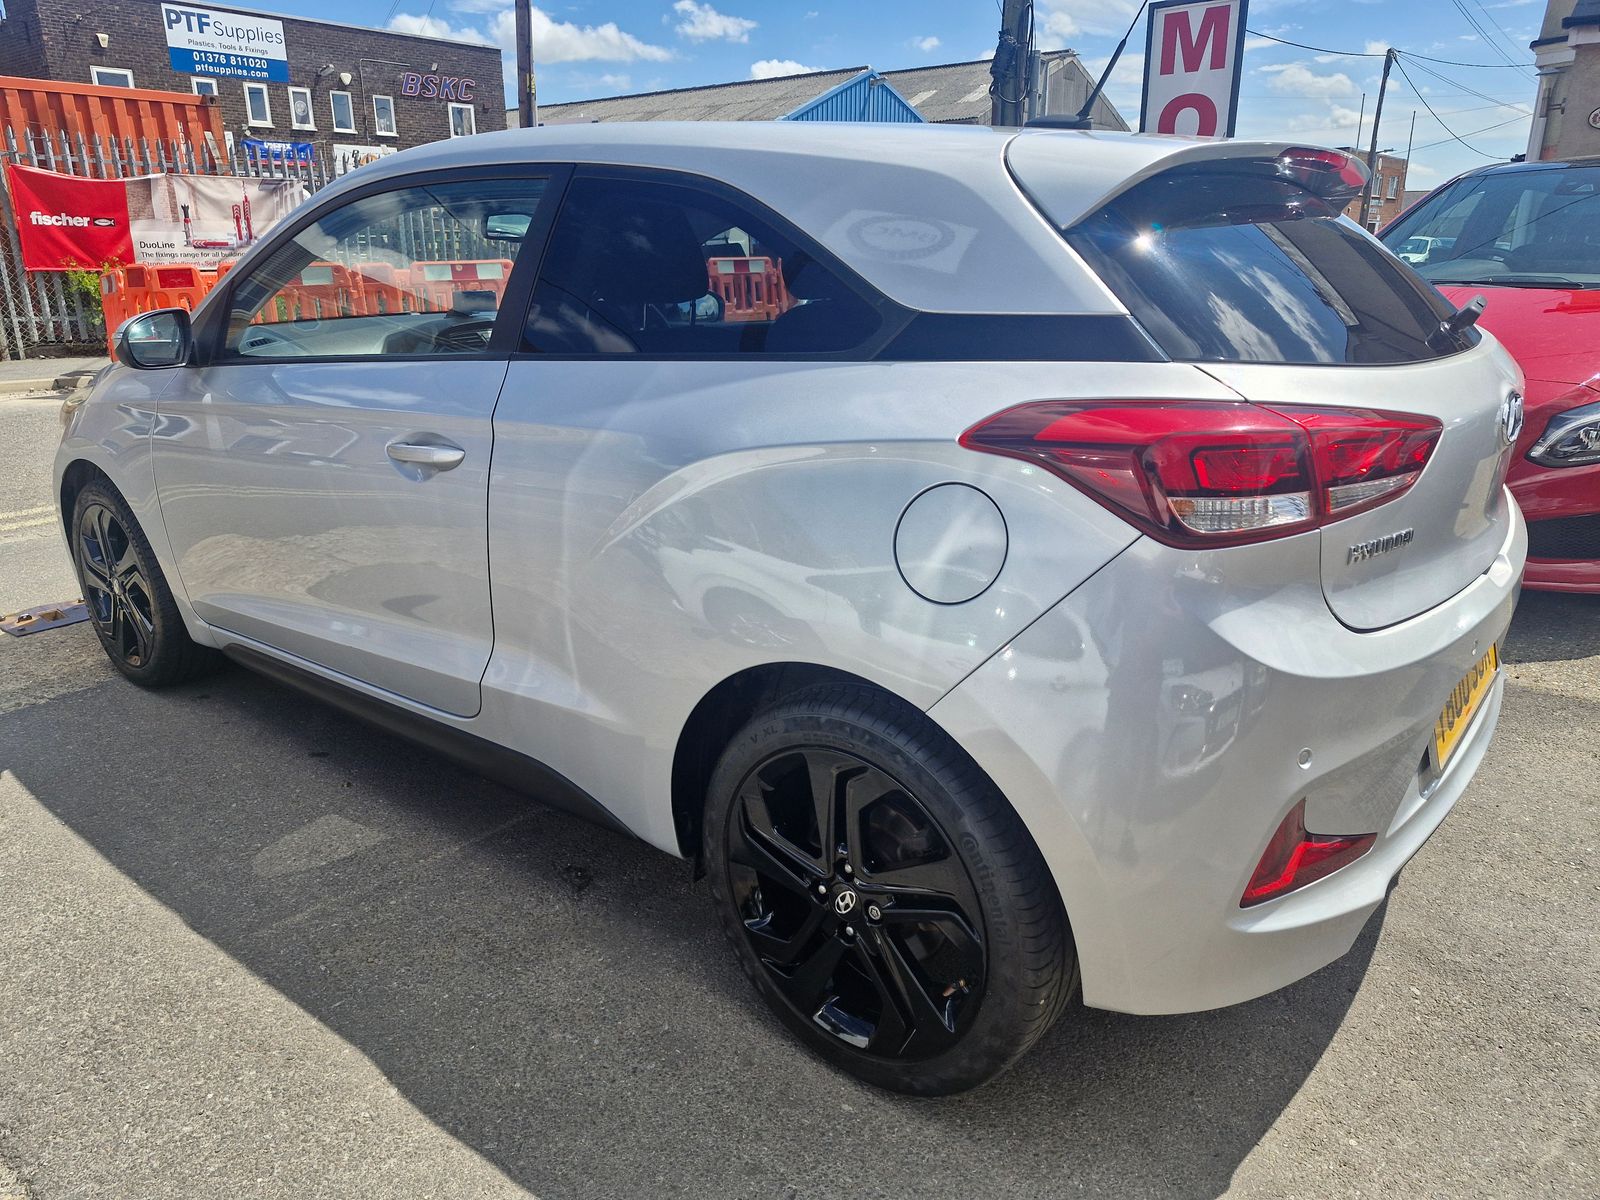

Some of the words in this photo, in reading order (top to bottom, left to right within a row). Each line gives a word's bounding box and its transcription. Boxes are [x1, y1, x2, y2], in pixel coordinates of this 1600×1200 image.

[164, 8, 211, 34] PTF
[213, 20, 283, 45] Supplies
[187, 38, 217, 49] Plastics,
[218, 42, 237, 52] Tools
[244, 45, 269, 56] Fixings
[192, 51, 227, 64] 01376
[230, 54, 268, 69] 811020
[195, 63, 269, 78] ptfsupplies.com
[401, 72, 476, 101] BSKC
[29, 211, 90, 227] fischer
[139, 241, 175, 249] DuoLine
[156, 251, 179, 260] fixings
[1346, 527, 1414, 566] HYUNDAI
